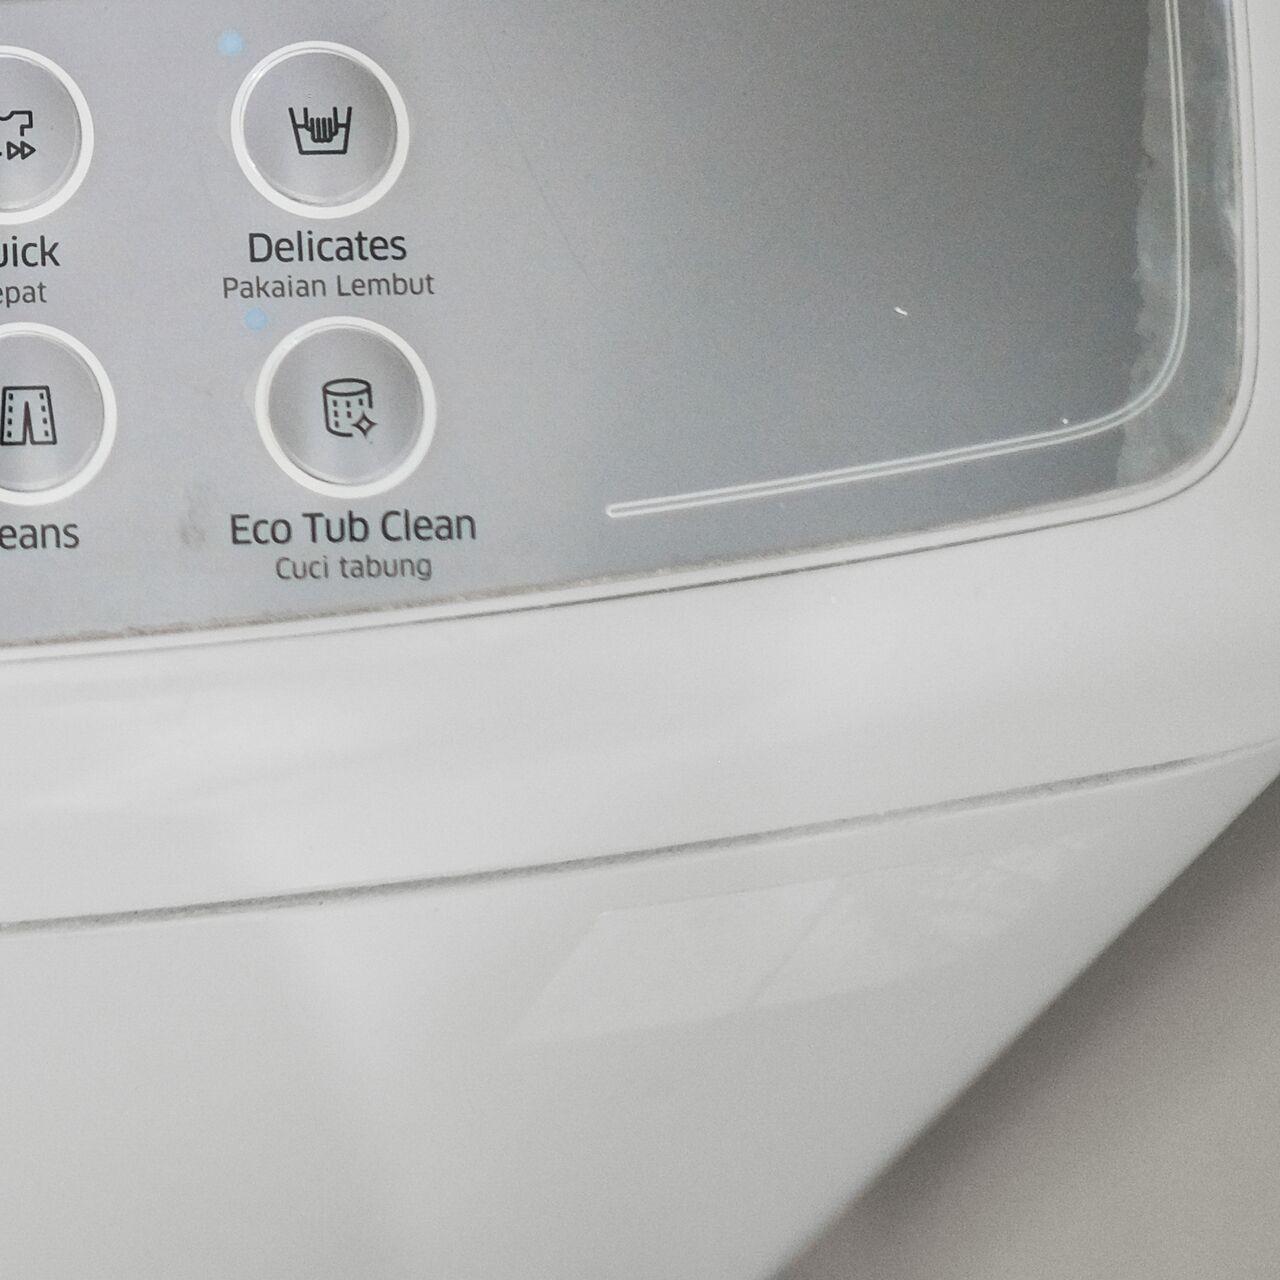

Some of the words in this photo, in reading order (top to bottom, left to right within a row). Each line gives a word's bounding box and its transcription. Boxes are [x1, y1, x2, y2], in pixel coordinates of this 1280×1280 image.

[248, 231, 407, 263] Delicates
[222, 274, 327, 299] Pakaian
[337, 273, 435, 297] Lembut
[230, 513, 292, 545] Eco
[302, 511, 370, 544] Tub
[380, 509, 477, 542] Clean
[275, 556, 330, 581] Cuci
[339, 554, 433, 581] tabung
